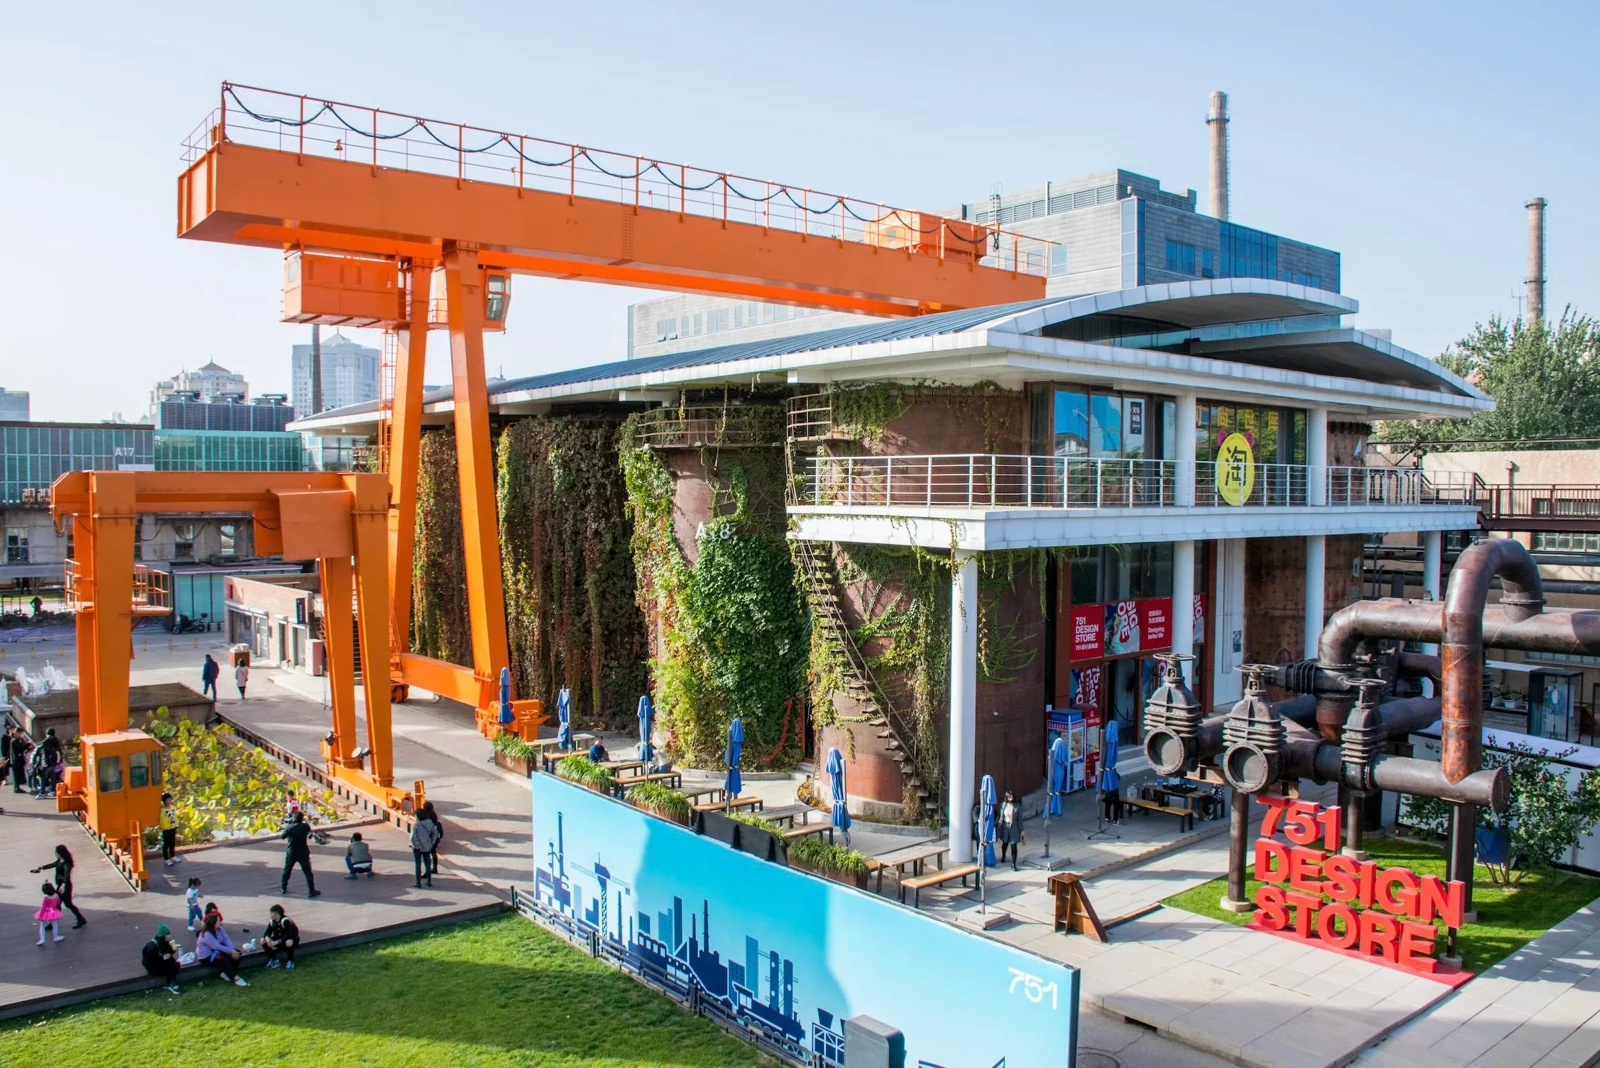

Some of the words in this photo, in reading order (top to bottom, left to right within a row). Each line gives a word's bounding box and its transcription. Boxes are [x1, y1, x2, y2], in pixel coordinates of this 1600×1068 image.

[115, 447, 135, 457] A17
[1075, 616, 1086, 625] 751
[1075, 624, 1099, 634] DESIGN
[1075, 632, 1096, 643] STORE
[1256, 795, 1341, 850] 751
[1255, 838, 1465, 929] DESIGN
[1255, 885, 1438, 973] STORE
[1008, 966, 1058, 1010] 751
